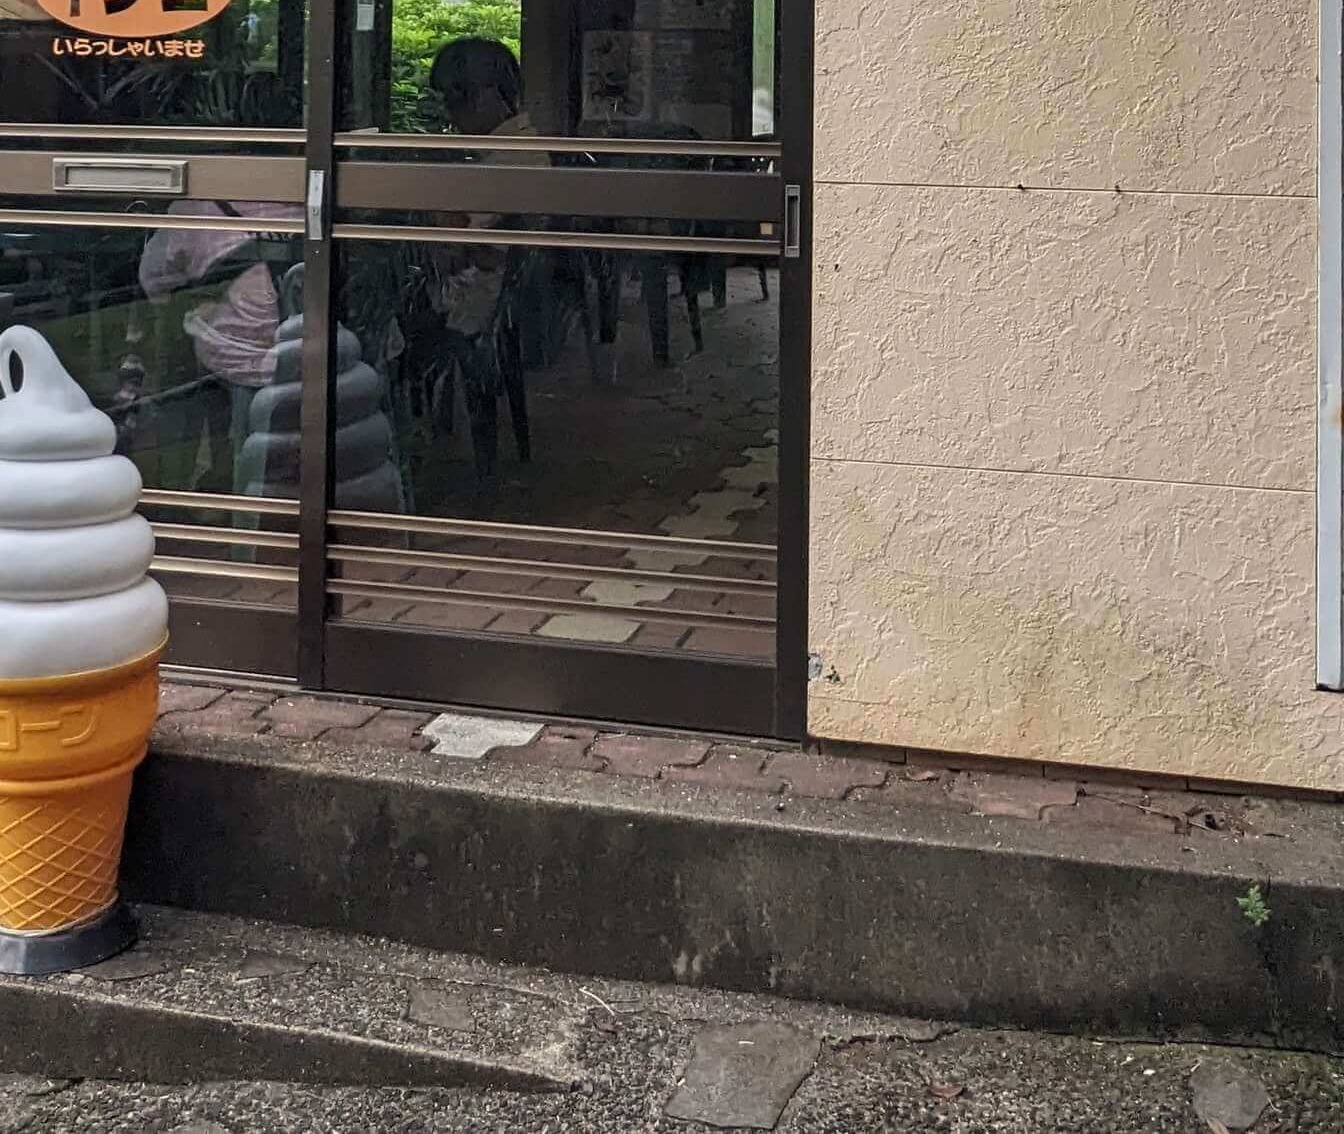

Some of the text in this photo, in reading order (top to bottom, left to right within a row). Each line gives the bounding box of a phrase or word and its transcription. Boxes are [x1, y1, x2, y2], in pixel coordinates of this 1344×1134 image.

[53, 38, 206, 59] いらっしゃいませ
